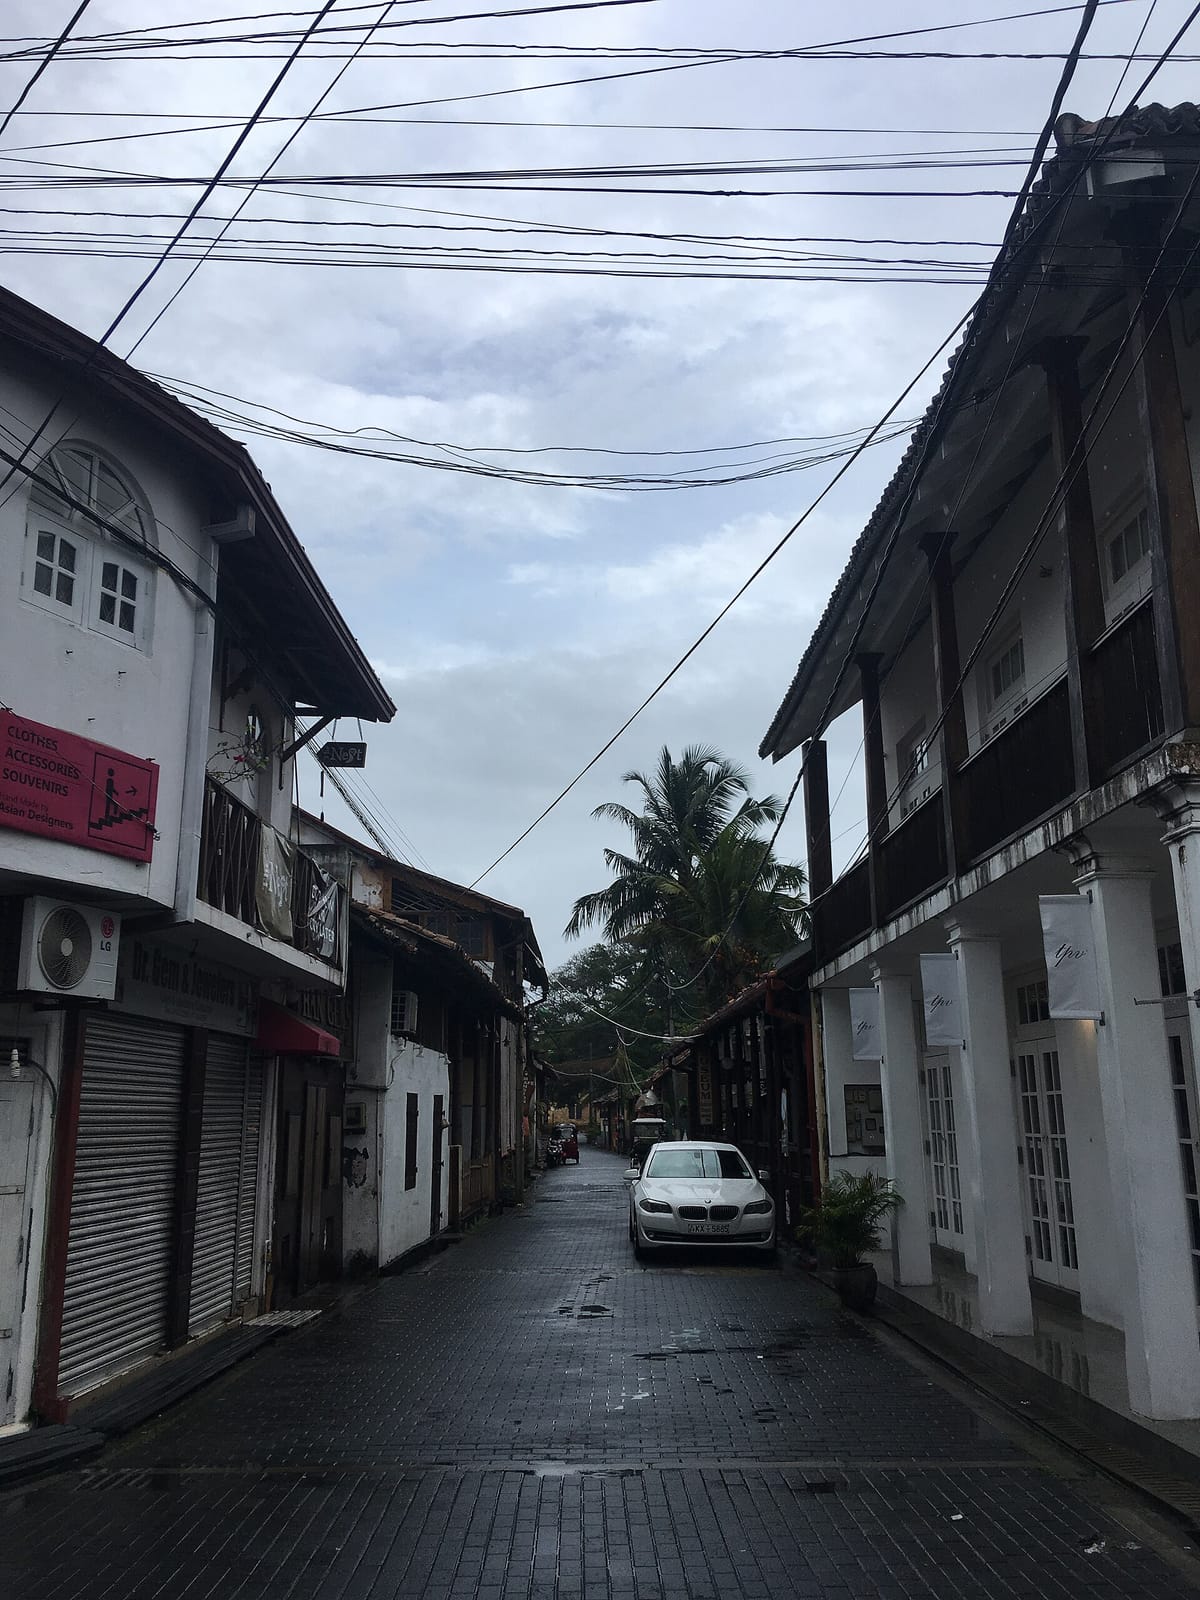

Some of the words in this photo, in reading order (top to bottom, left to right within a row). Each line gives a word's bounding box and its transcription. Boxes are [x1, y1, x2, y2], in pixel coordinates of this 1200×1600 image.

[7, 726, 58, 751] CLOTHES
[4, 747, 81, 780] ACCESSORIES
[2, 768, 69, 797] SOUVENIRS
[0, 800, 25, 817] Asian
[28, 808, 74, 831] Designers
[100, 940, 111, 952] LG
